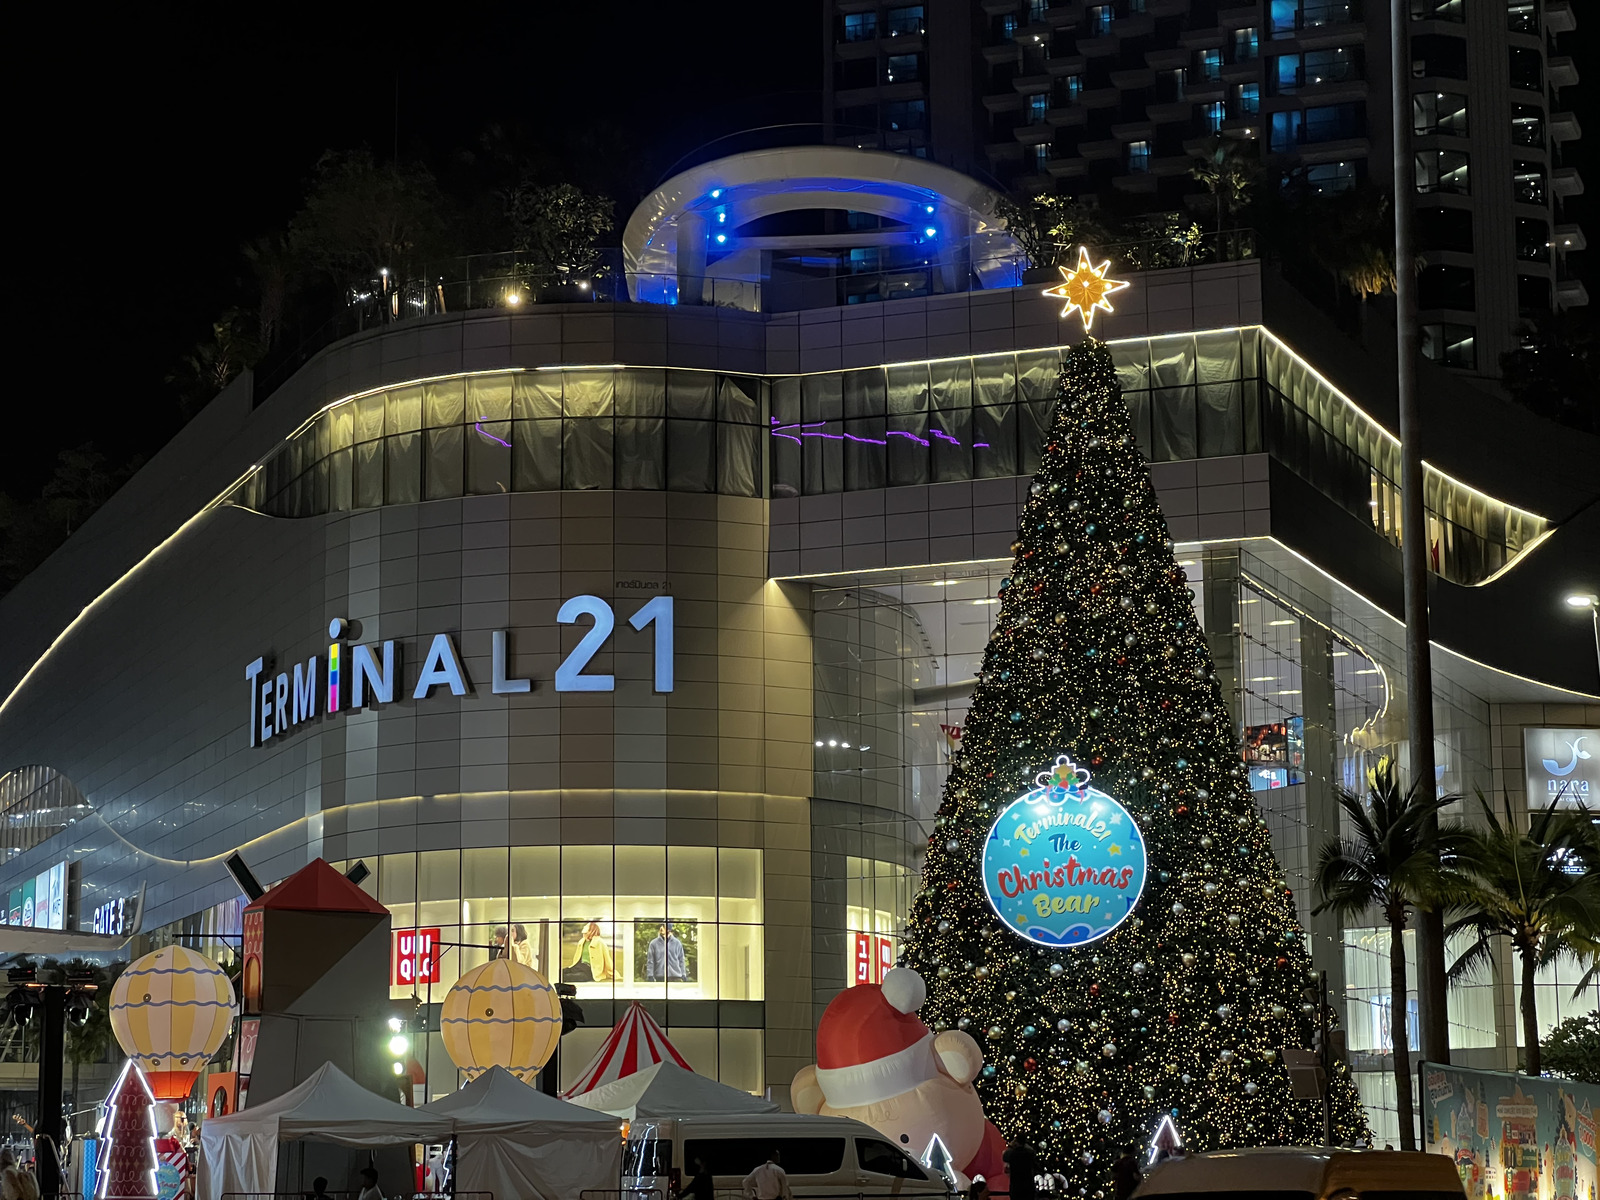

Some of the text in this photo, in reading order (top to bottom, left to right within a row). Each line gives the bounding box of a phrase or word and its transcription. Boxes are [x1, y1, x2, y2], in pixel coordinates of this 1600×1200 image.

[555, 594, 674, 693] 21
[1548, 778, 1589, 792] nara
[1013, 807, 1112, 845] Terminal21
[1048, 833, 1082, 853] The
[997, 853, 1134, 898] Christmas
[92, 899, 116, 935] GATE
[117, 897, 124, 935] 3
[1032, 893, 1100, 918] Bear
